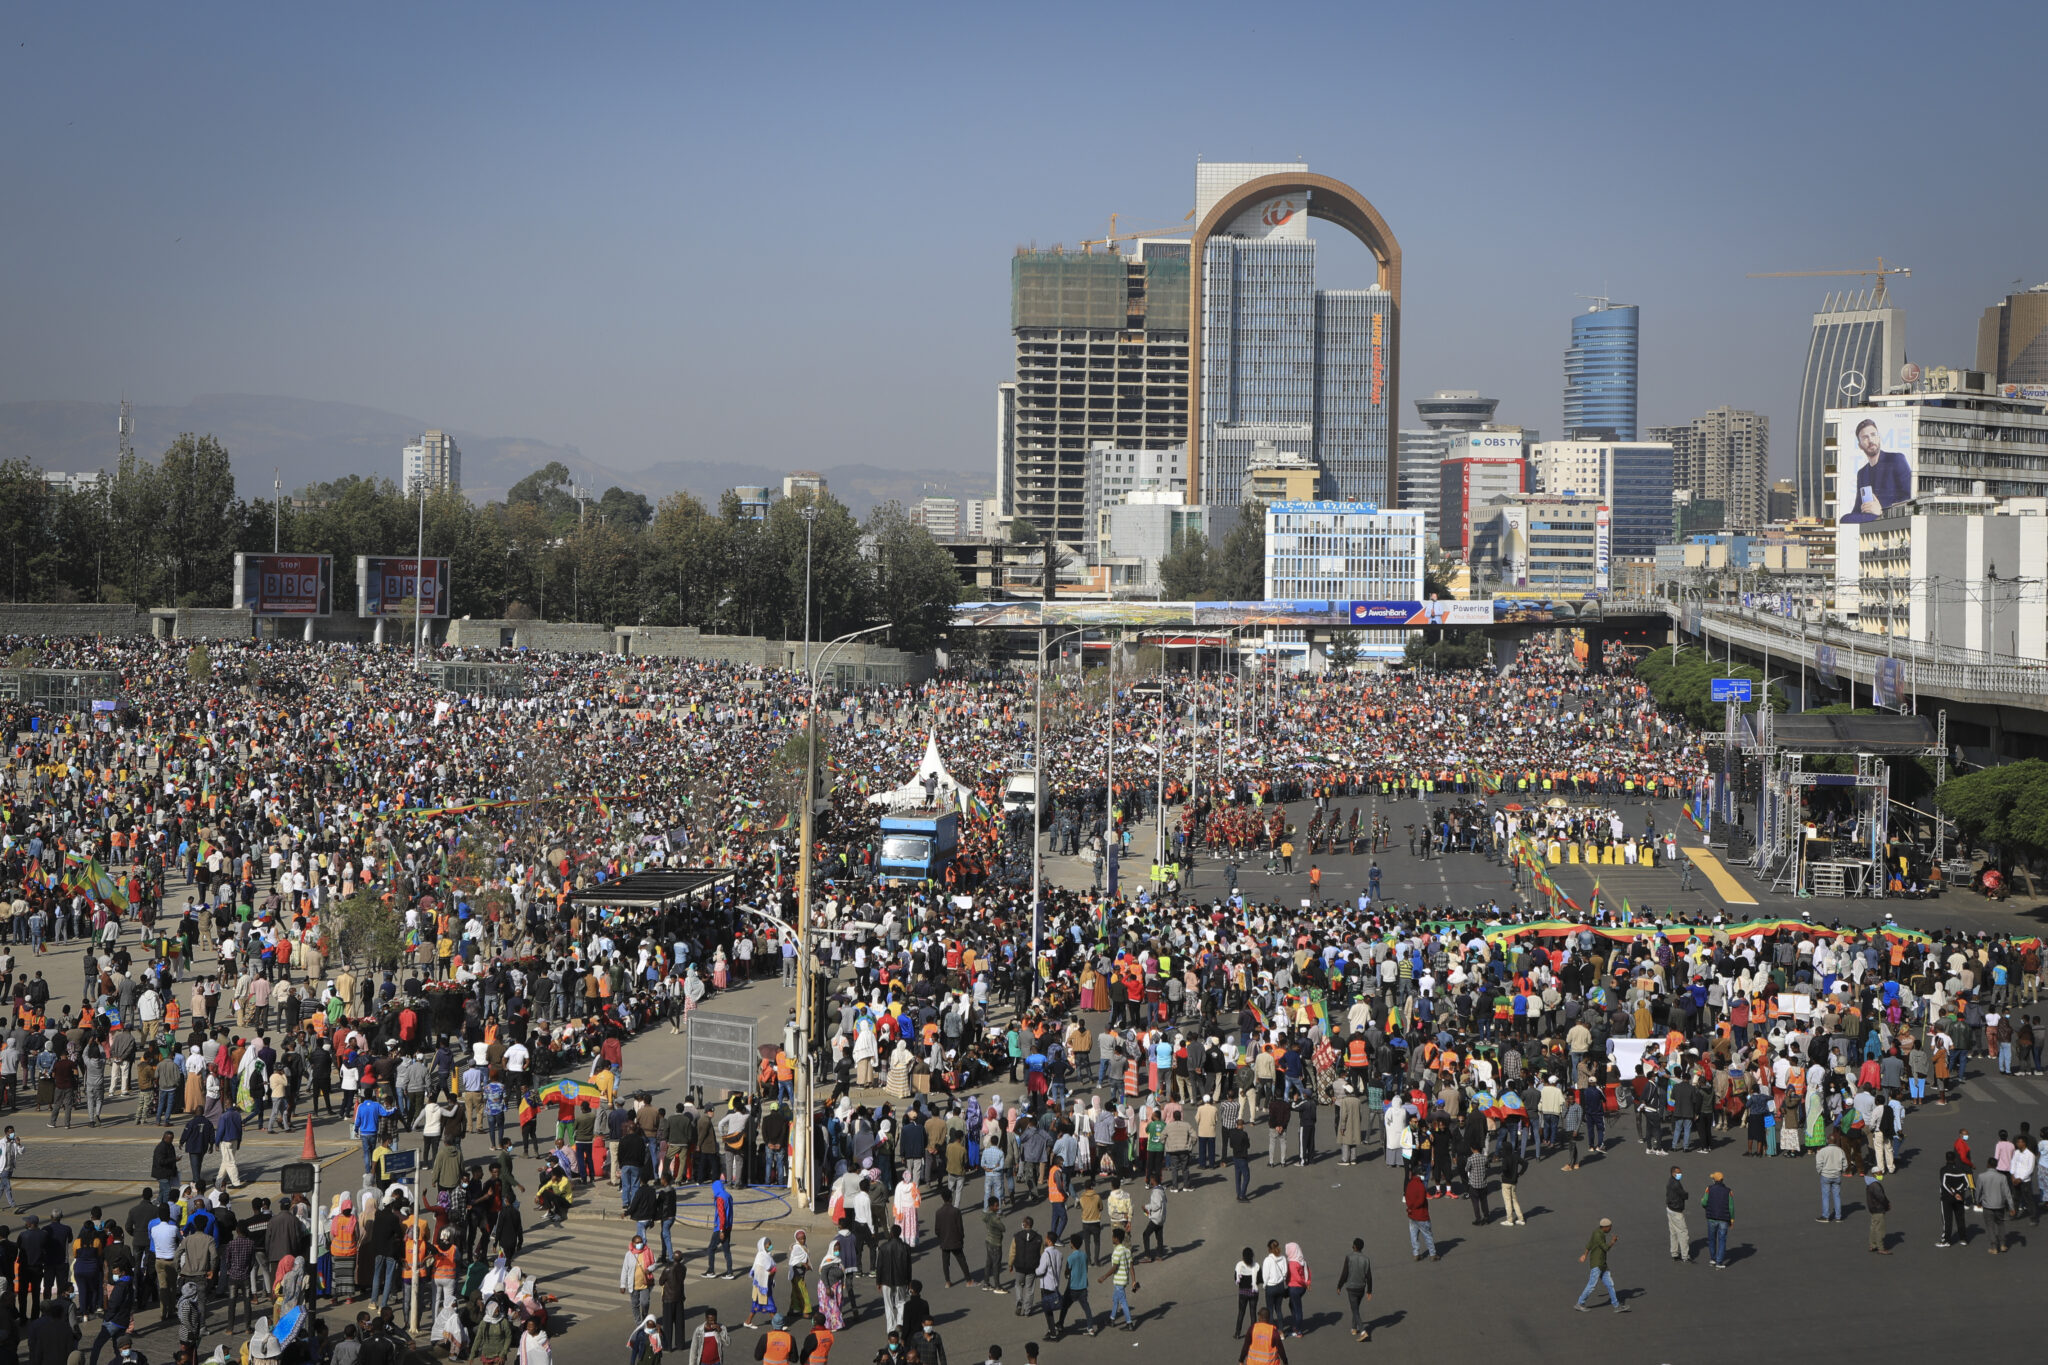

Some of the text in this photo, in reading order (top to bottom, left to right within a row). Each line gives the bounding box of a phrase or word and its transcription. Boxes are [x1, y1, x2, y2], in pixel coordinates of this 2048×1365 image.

[1371, 313, 1384, 404] Wegagen Bank
[1925, 365, 1948, 379] LG
[1484, 437, 1522, 447] OBS TV
[280, 561, 299, 569] STOP
[267, 575, 314, 595] BBC
[388, 578, 432, 595] BBC
[1453, 604, 1490, 614] Powering
